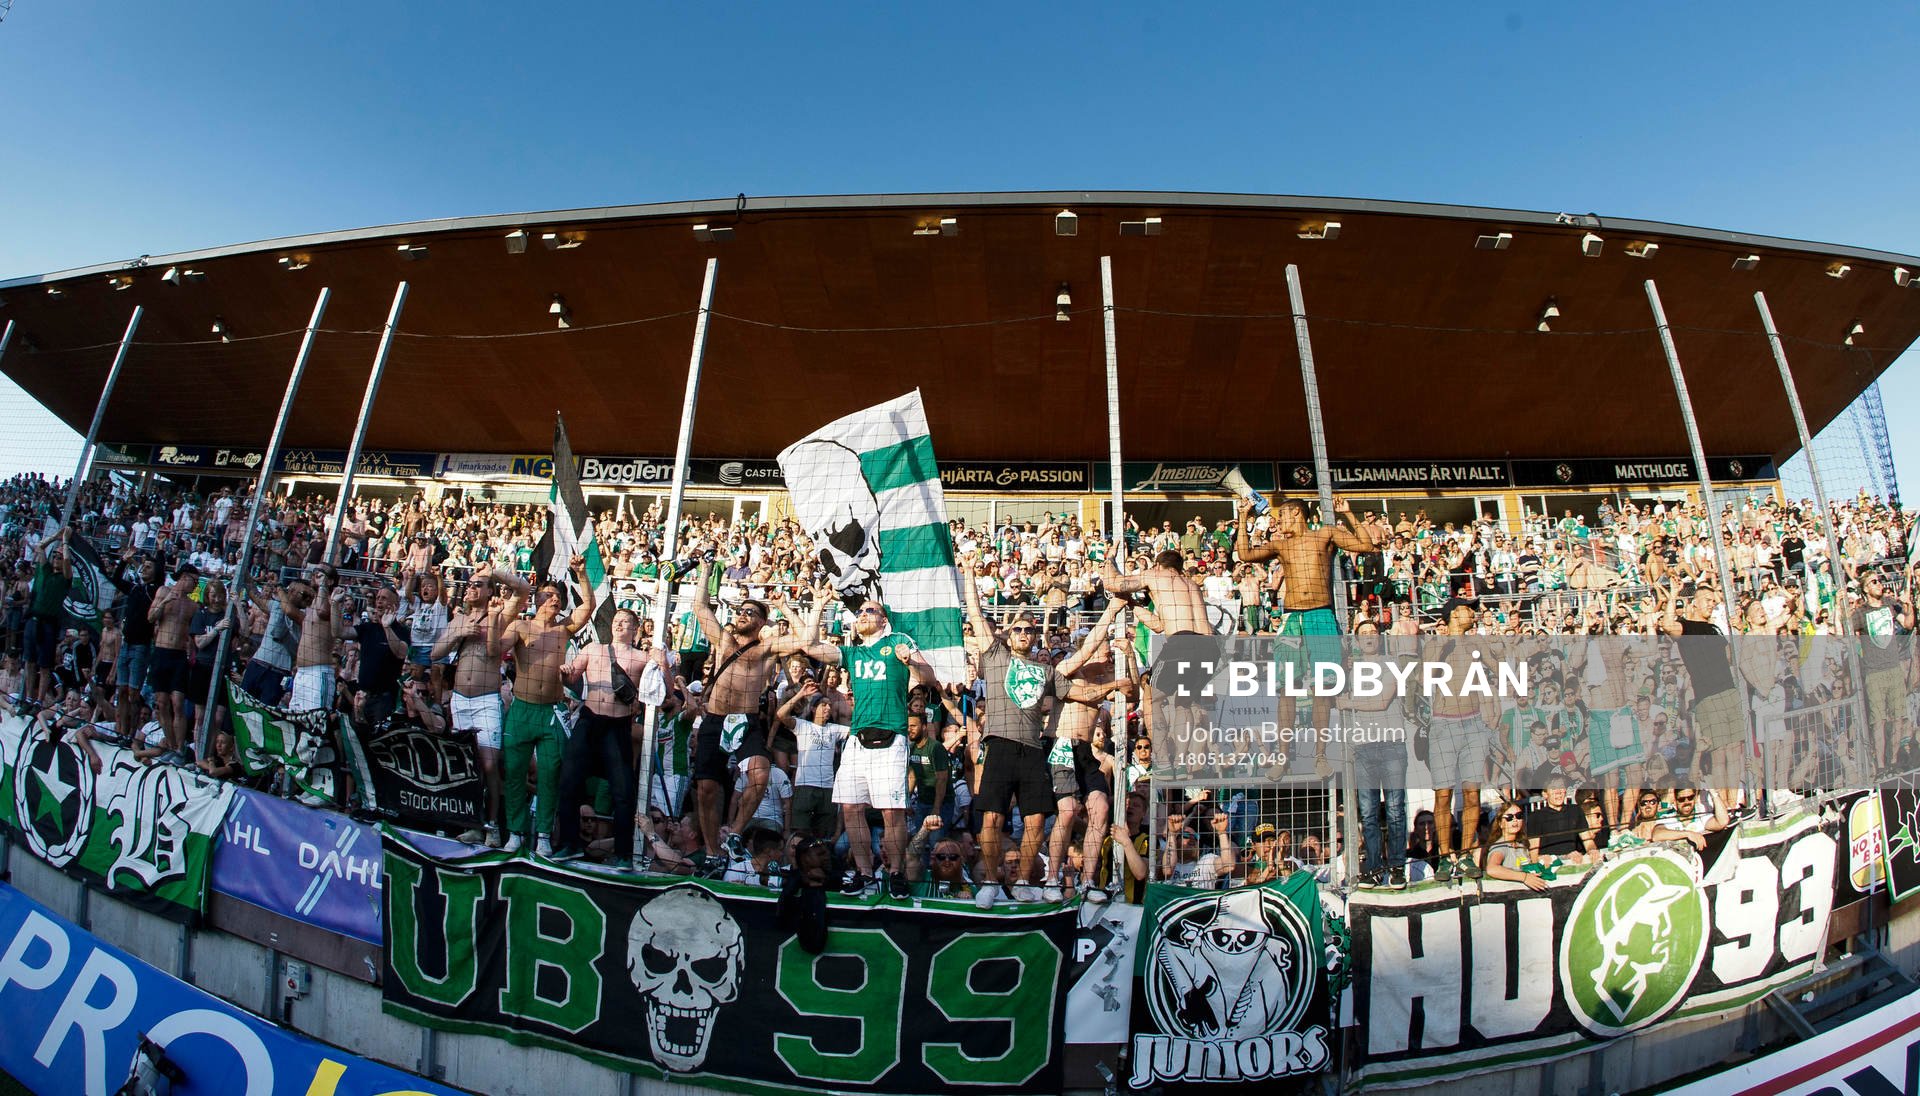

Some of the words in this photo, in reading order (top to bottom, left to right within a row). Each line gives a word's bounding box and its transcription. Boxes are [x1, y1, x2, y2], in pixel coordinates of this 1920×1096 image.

[940, 467, 994, 484] HJÄRTA
[1020, 470, 1083, 482] PASSION
[1430, 464, 1451, 481] ÄR
[1451, 467, 1467, 480] VI
[1469, 466, 1505, 480] ALLT.
[1615, 463, 1689, 479] MATCHLOGE
[399, 790, 475, 816] STOCKHOLM
[1712, 832, 1837, 985] 93
[382, 851, 607, 1035] UB
[773, 927, 1064, 1086] 99
[1368, 897, 1555, 1056] HU
[1128, 1025, 1330, 1090] JUNIORS
